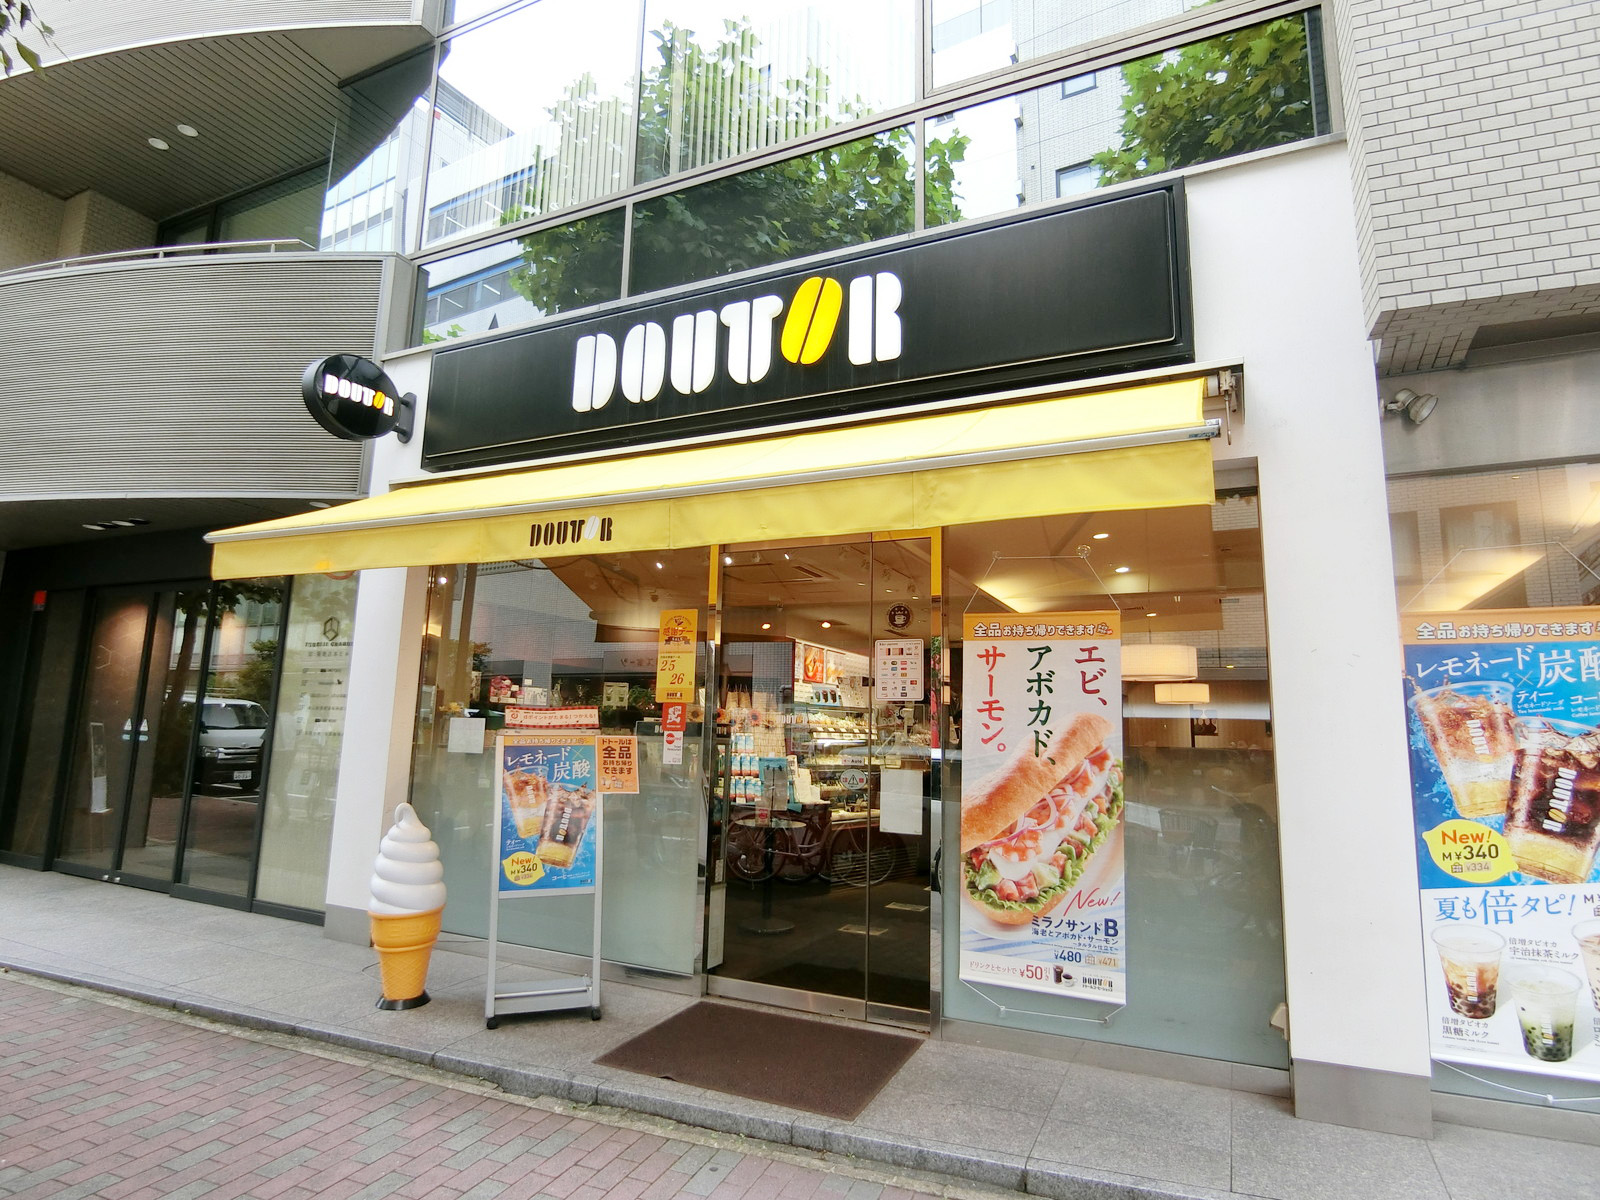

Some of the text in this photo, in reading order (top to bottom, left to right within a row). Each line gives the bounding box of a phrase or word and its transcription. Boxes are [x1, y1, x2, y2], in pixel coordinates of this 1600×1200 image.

[572, 272, 902, 413] DOUTOR
[324, 373, 394, 417] DOUTOR
[529, 515, 613, 547] DOUTOR
[974, 622, 1096, 638] 全品お持ち帰りできます
[1416, 621, 1593, 640] 全品お持ち帰りできます
[660, 660, 676, 672] 25
[1416, 645, 1535, 679] レモネード
[669, 673, 685, 685] 26
[1074, 646, 1107, 706] エビ、
[976, 645, 1007, 752] サーモン。
[1026, 645, 1056, 766] アボカド、
[1516, 691, 1553, 704] ティー
[508, 746, 572, 766] レモネード
[602, 745, 632, 759] 全品
[552, 759, 592, 782] 炭酸
[602, 759, 633, 767] お持ち帰り
[603, 766, 633, 775] できます
[1542, 767, 1578, 832] DOUTOR
[1441, 829, 1492, 845] New!
[511, 856, 536, 867] New!
[1442, 843, 1499, 861] M ¥340
[1466, 862, 1490, 871] ¥334
[1063, 887, 1121, 917] New!
[1433, 889, 1576, 925] 夏も倍タピ!
[1031, 914, 1119, 937] ミラノサンドB
[1054, 950, 1082, 964] ¥480
[1019, 964, 1043, 981] ¥50
